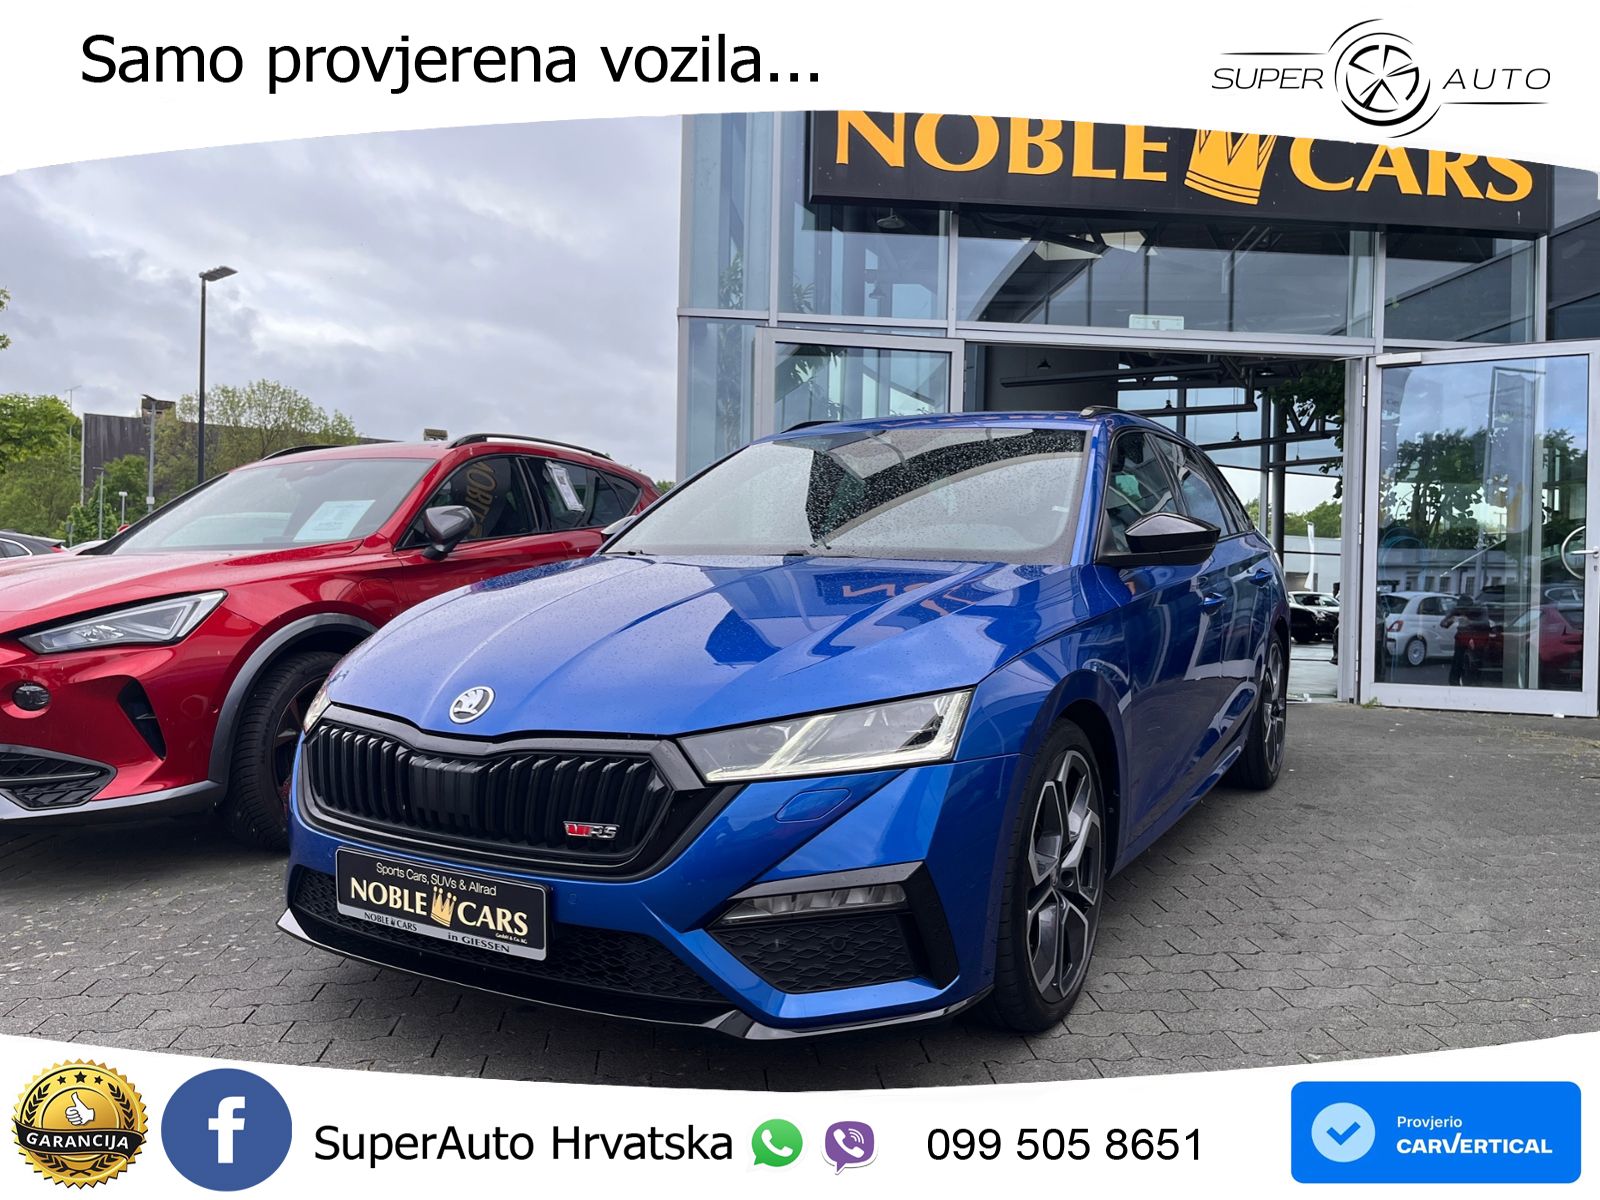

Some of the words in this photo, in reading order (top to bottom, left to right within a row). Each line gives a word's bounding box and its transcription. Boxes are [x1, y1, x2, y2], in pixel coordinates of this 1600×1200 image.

[836, 110, 1166, 182] NOBLE
[1290, 137, 1534, 203] CARS
[376, 862, 405, 880] Sports
[406, 868, 430, 885] Cars,
[430, 873, 457, 889] SUVs
[458, 880, 467, 891] &
[468, 881, 497, 897] Allrad
[350, 876, 428, 916] NOBLE
[457, 901, 529, 936] CARS
[364, 911, 390, 926] NOBLE
[396, 919, 418, 932] CARS
[447, 930, 459, 941] in
[461, 935, 510, 953] GIESSEN
